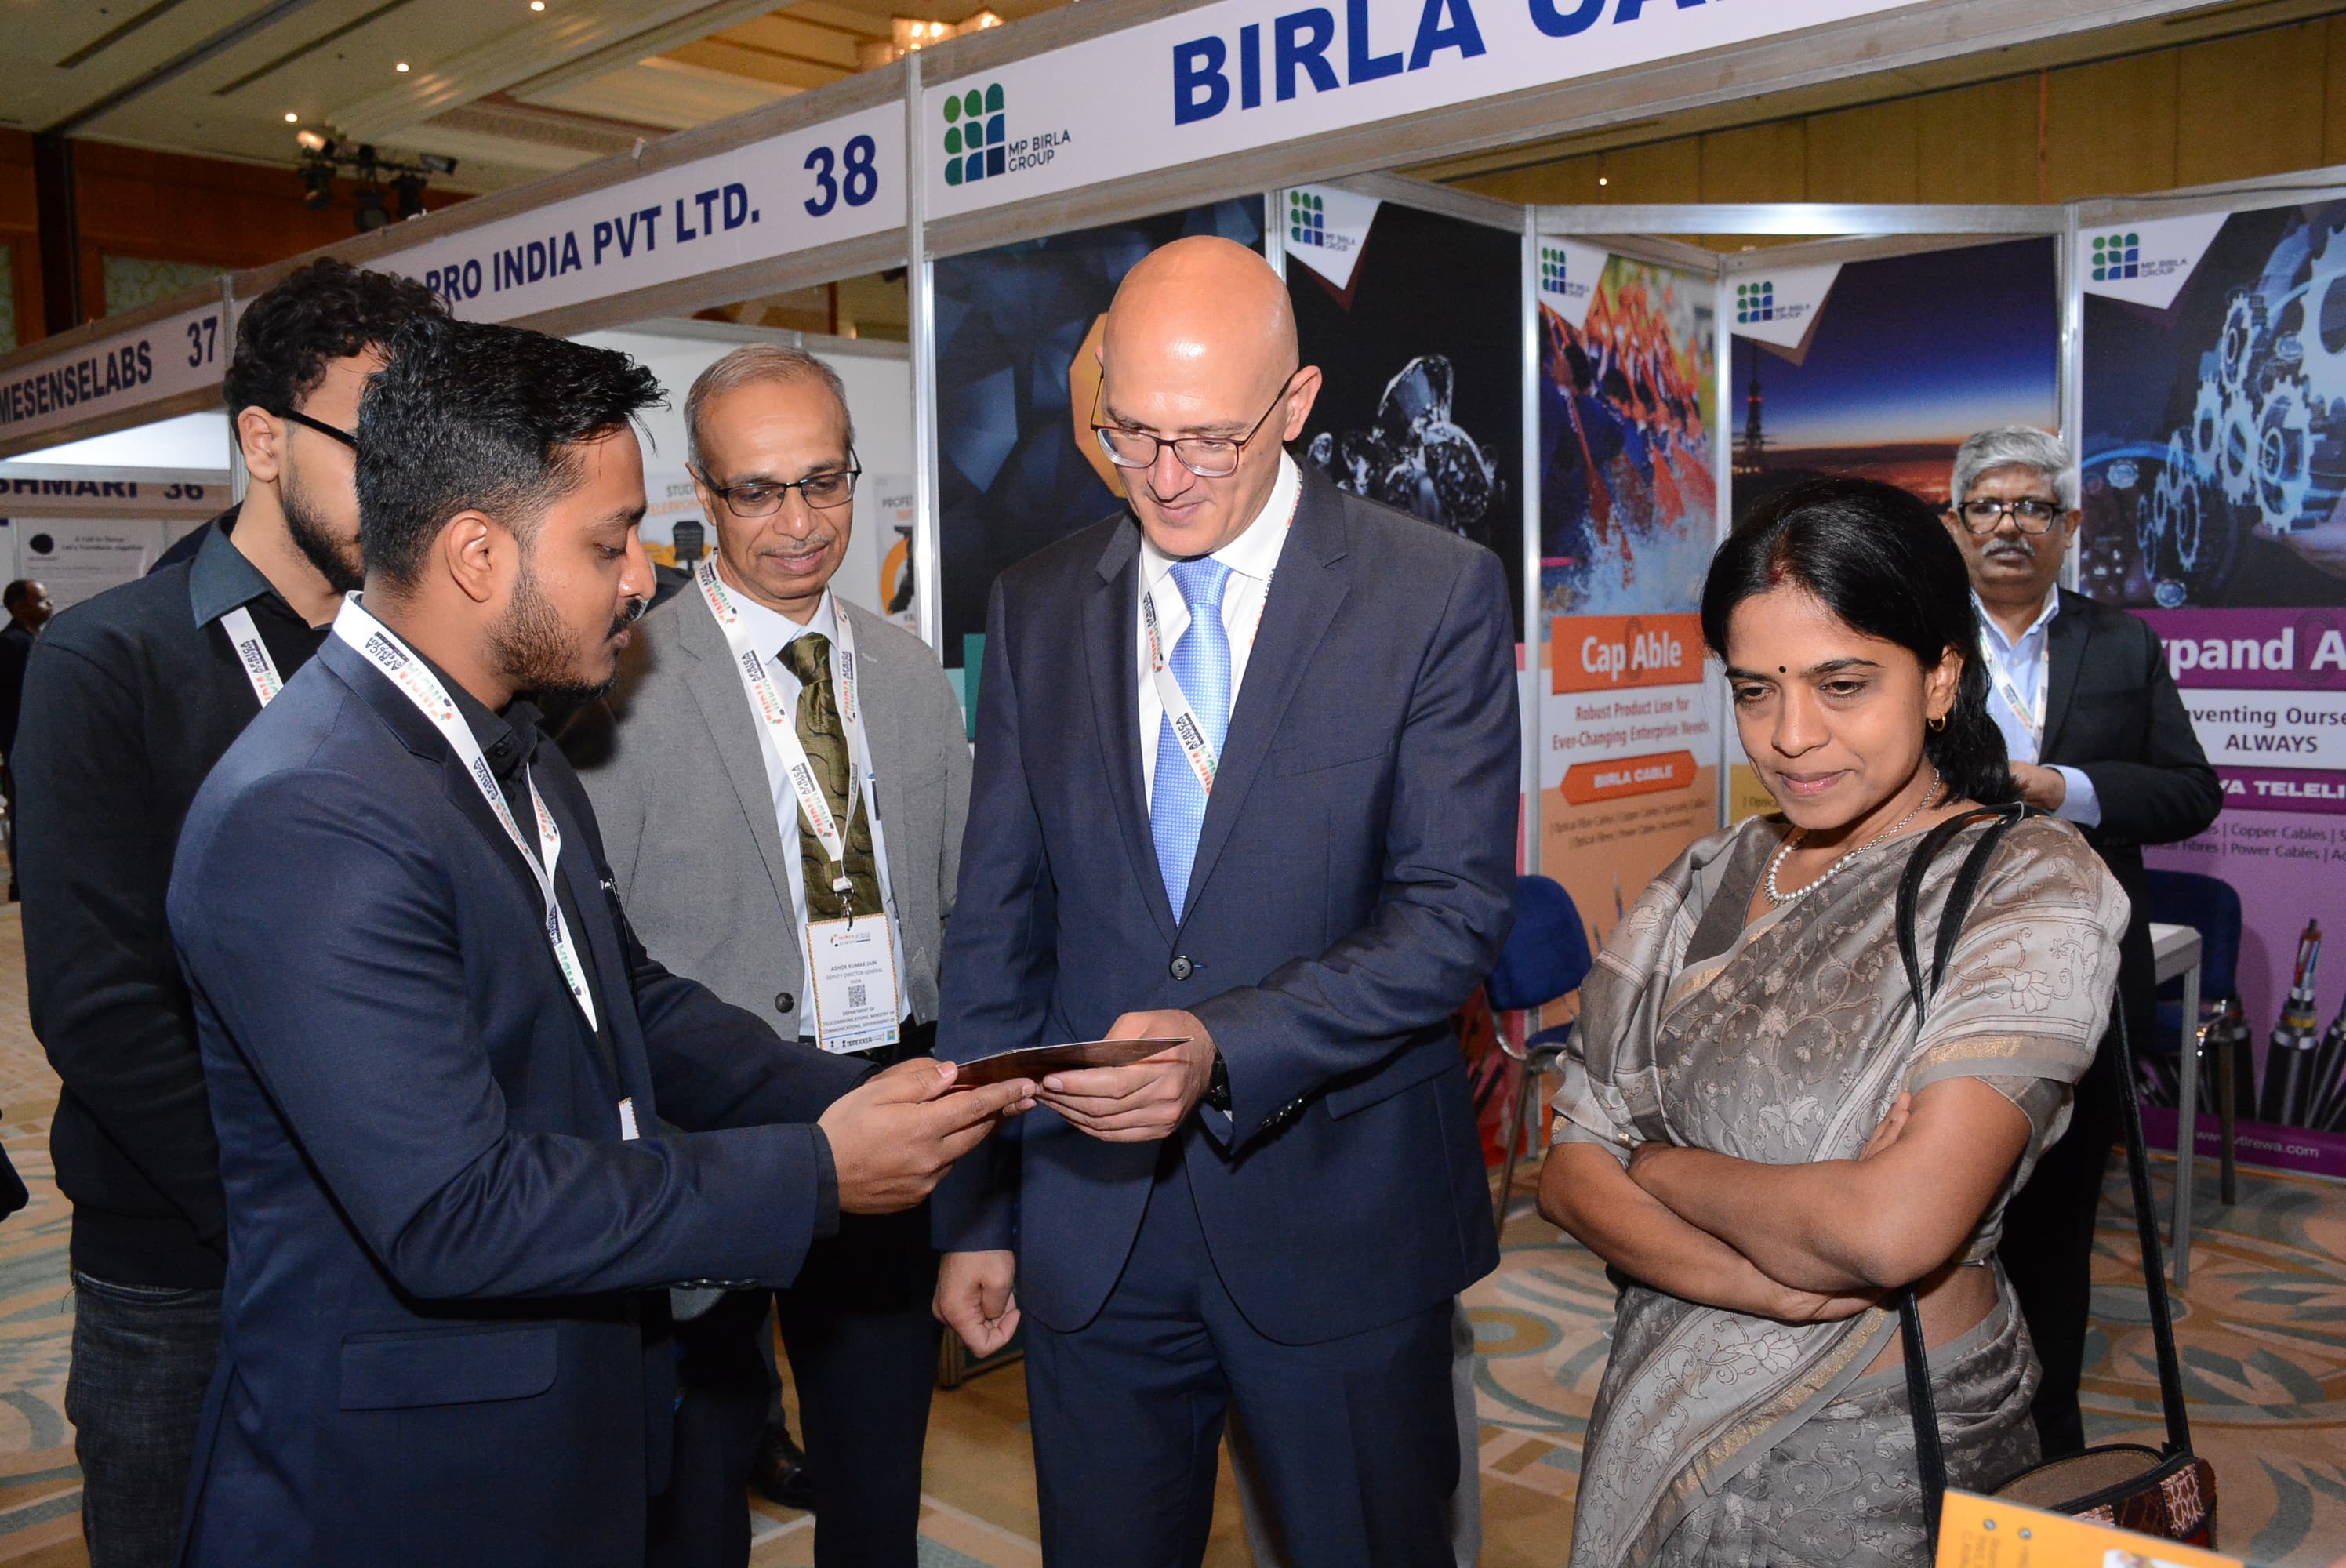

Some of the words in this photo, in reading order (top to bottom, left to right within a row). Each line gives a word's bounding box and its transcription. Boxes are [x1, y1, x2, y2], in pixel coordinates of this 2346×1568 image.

[1172, 0, 1487, 126] BIRLA
[1008, 140, 1028, 158] MP
[1032, 129, 1072, 153] BIRLA
[1008, 148, 1055, 173] GROUP
[426, 258, 482, 302] PRO
[493, 230, 582, 292] INDIA
[594, 205, 662, 266] PVT
[675, 181, 761, 245] LTD.
[803, 133, 878, 217] 38
[0, 340, 153, 424] MESENSELABS
[187, 315, 218, 368] 37
[239, 641, 261, 674] AFRICA
[364, 639, 399, 672] AFRICA
[741, 654, 758, 683] AFRICA
[1581, 635, 1627, 681] Cap
[1632, 630, 1683, 670] Able
[2161, 627, 2294, 681] pand
[2310, 630, 2346, 670] A
[1576, 703, 1611, 721] Robust
[1614, 700, 1652, 717] Product
[1654, 699, 1672, 713] Line
[1676, 696, 1690, 711] for
[1175, 717, 1195, 750] AFRICA
[1552, 728, 1627, 750] Ever-Changing
[1631, 724, 1678, 742] Enterprise
[2225, 734, 2319, 753] ALWAYS
[790, 766, 808, 795] AFRICA
[1593, 770, 1632, 789] BIRLA
[1634, 764, 1673, 782] CABLE
[2231, 822, 2278, 839] Copper
[2282, 825, 2326, 842] Cables
[2232, 842, 2271, 856] Power
[2275, 845, 2319, 860] Cables
